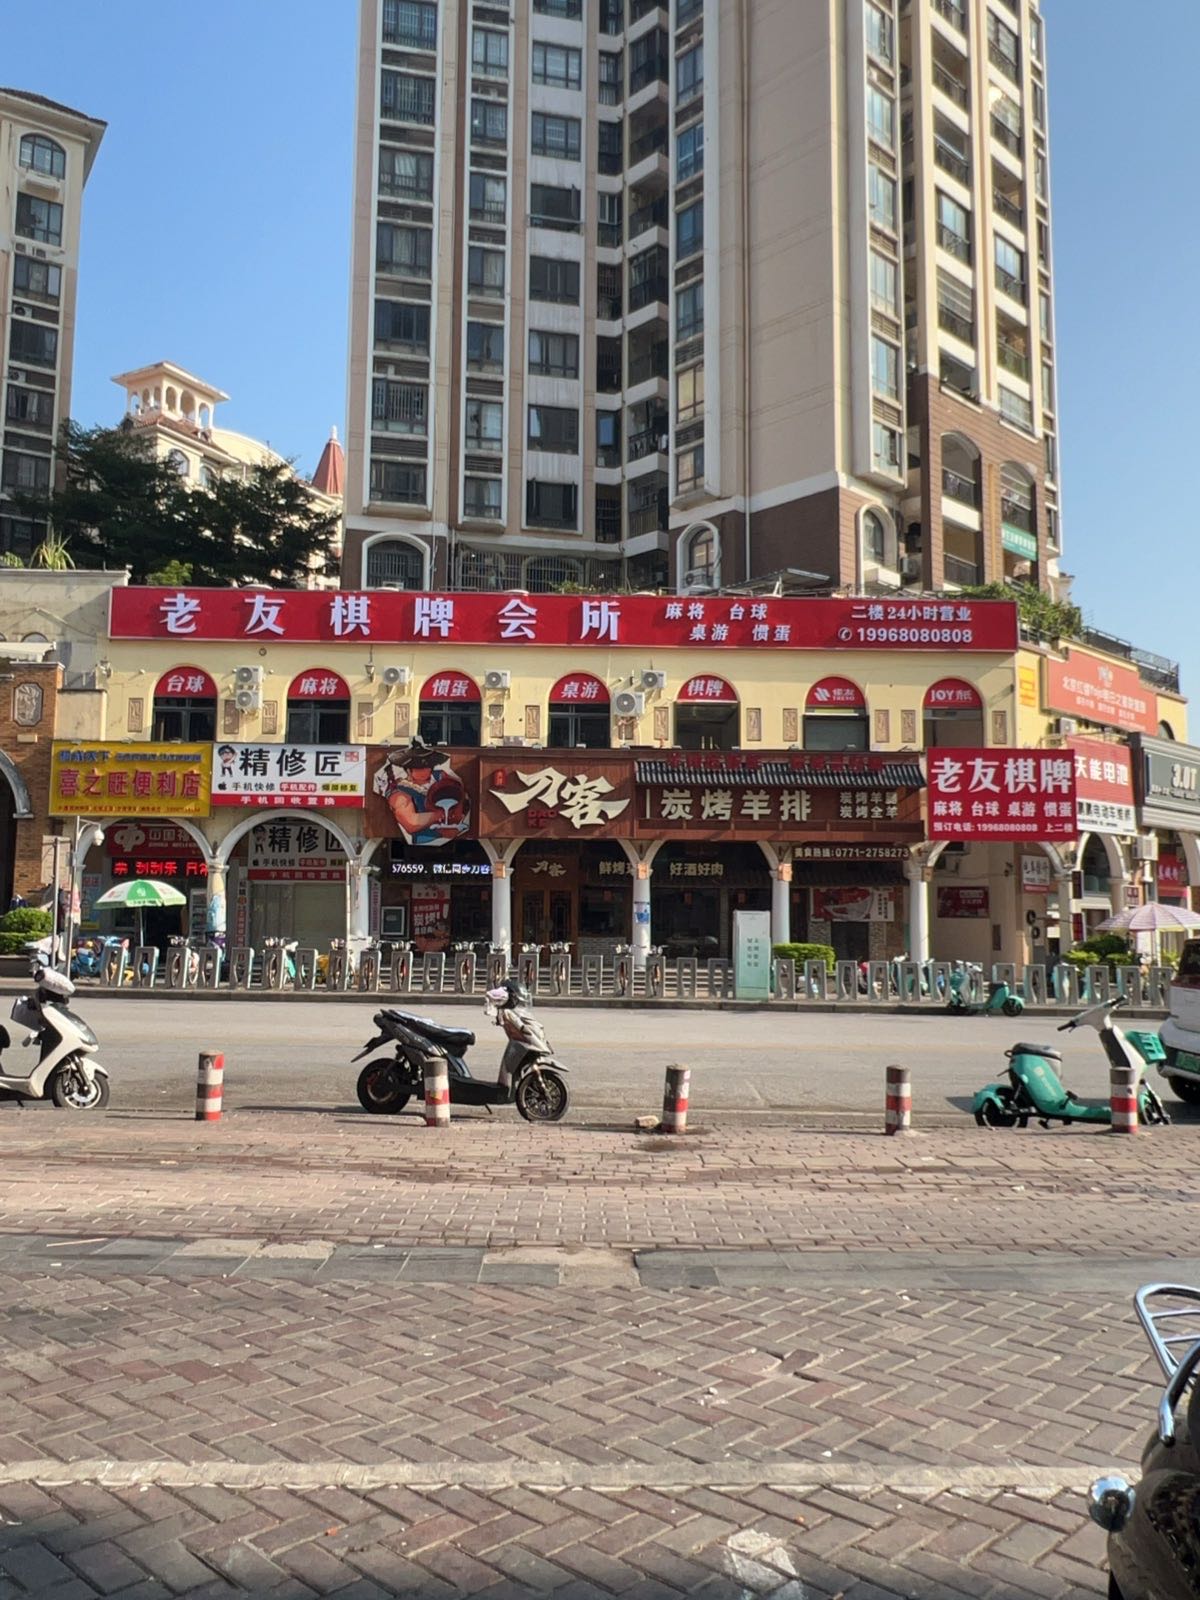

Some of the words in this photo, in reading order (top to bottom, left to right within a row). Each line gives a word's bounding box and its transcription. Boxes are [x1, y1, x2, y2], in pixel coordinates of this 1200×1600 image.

[160, 592, 621, 641] 老友棋牌会所
[665, 602, 705, 620] 麻将
[729, 603, 768, 620] 台球
[851, 604, 972, 621] 二楼24小时营业
[689, 623, 730, 641] 桌游
[752, 624, 791, 642] 惯蛋
[857, 628, 972, 643] 19968080808
[167, 675, 205, 693] 台球
[299, 677, 337, 695] 麻将
[432, 679, 469, 698] 惯蛋
[561, 681, 600, 698] 桌游
[688, 679, 724, 697] 棋牌
[930, 689, 954, 702] JOY
[239, 747, 342, 777] 精修匠
[1074, 755, 1129, 786] 天能电池
[59, 768, 201, 798] 喜之旺便利店
[931, 757, 1072, 794] 老友棋牌
[231, 782, 275, 791] 手机快修
[281, 783, 316, 792] 手机配件
[488, 766, 631, 829] 刀客
[661, 787, 812, 821] 炭烤羊排
[840, 805, 898, 819] 炭烤全羊
[934, 800, 963, 816] 麻将
[971, 800, 1000, 817] 台球
[1007, 801, 1036, 817] 桌游
[1043, 801, 1072, 817] 惯蛋
[977, 822, 1038, 833] 19968080808
[1044, 823, 1073, 833] 上二楼
[669, 861, 724, 876] 好酒好肉
